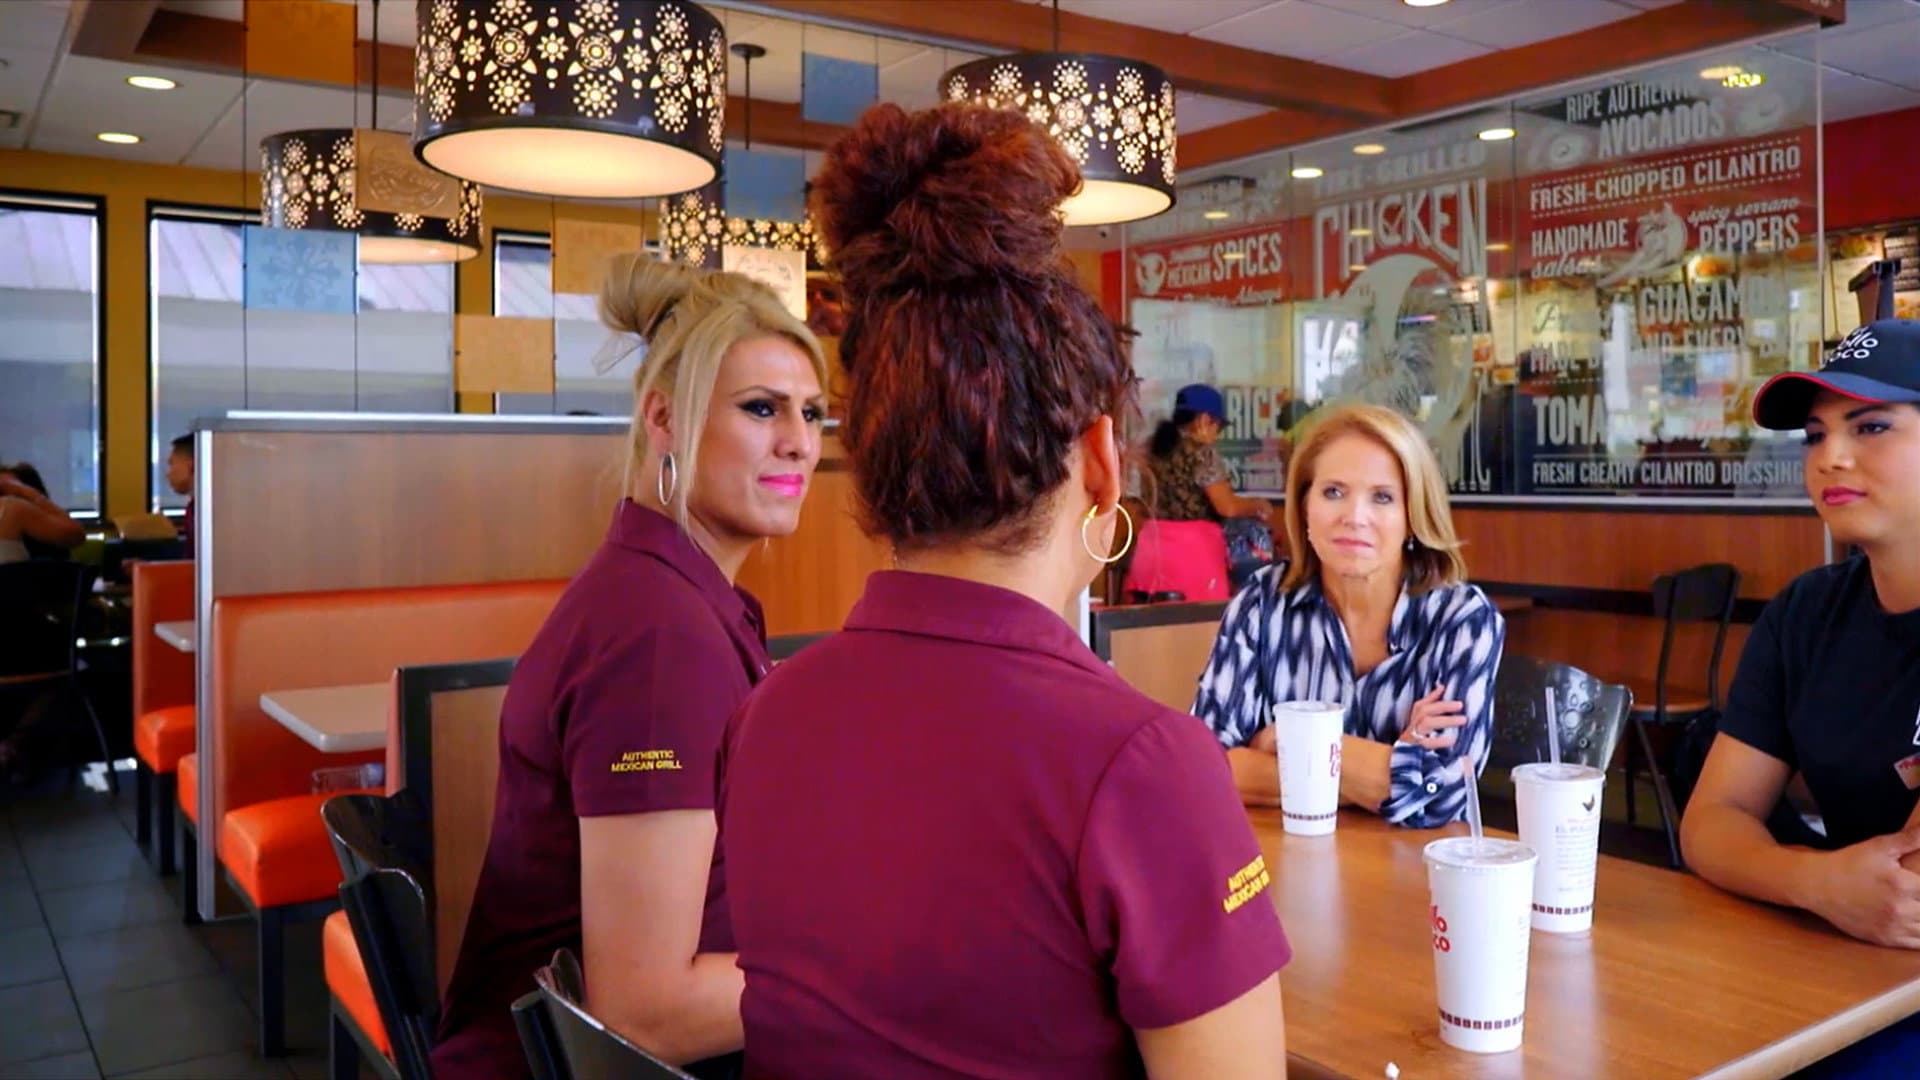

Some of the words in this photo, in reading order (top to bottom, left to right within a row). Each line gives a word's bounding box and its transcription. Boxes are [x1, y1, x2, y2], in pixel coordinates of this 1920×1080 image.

[1566, 91, 1601, 123] RIPE
[1598, 100, 1726, 159] AVOCADOS
[1530, 167, 1686, 211] FRESH-CHOPPED
[1693, 145, 1800, 186] CILANTRO
[1314, 177, 1488, 300] CHICKEN
[1531, 218, 1629, 257] HANDMADE
[1699, 213, 1800, 253] PEPPERS
[1212, 232, 1281, 281] SPICES
[1533, 461, 1575, 485] FRESH
[1580, 461, 1638, 485] CREAMY
[1641, 461, 1716, 485] CILANTRO
[611, 762, 655, 772] MEXICAN
[655, 759, 682, 770] GRILL
[622, 750, 674, 761] AUTHENTIC
